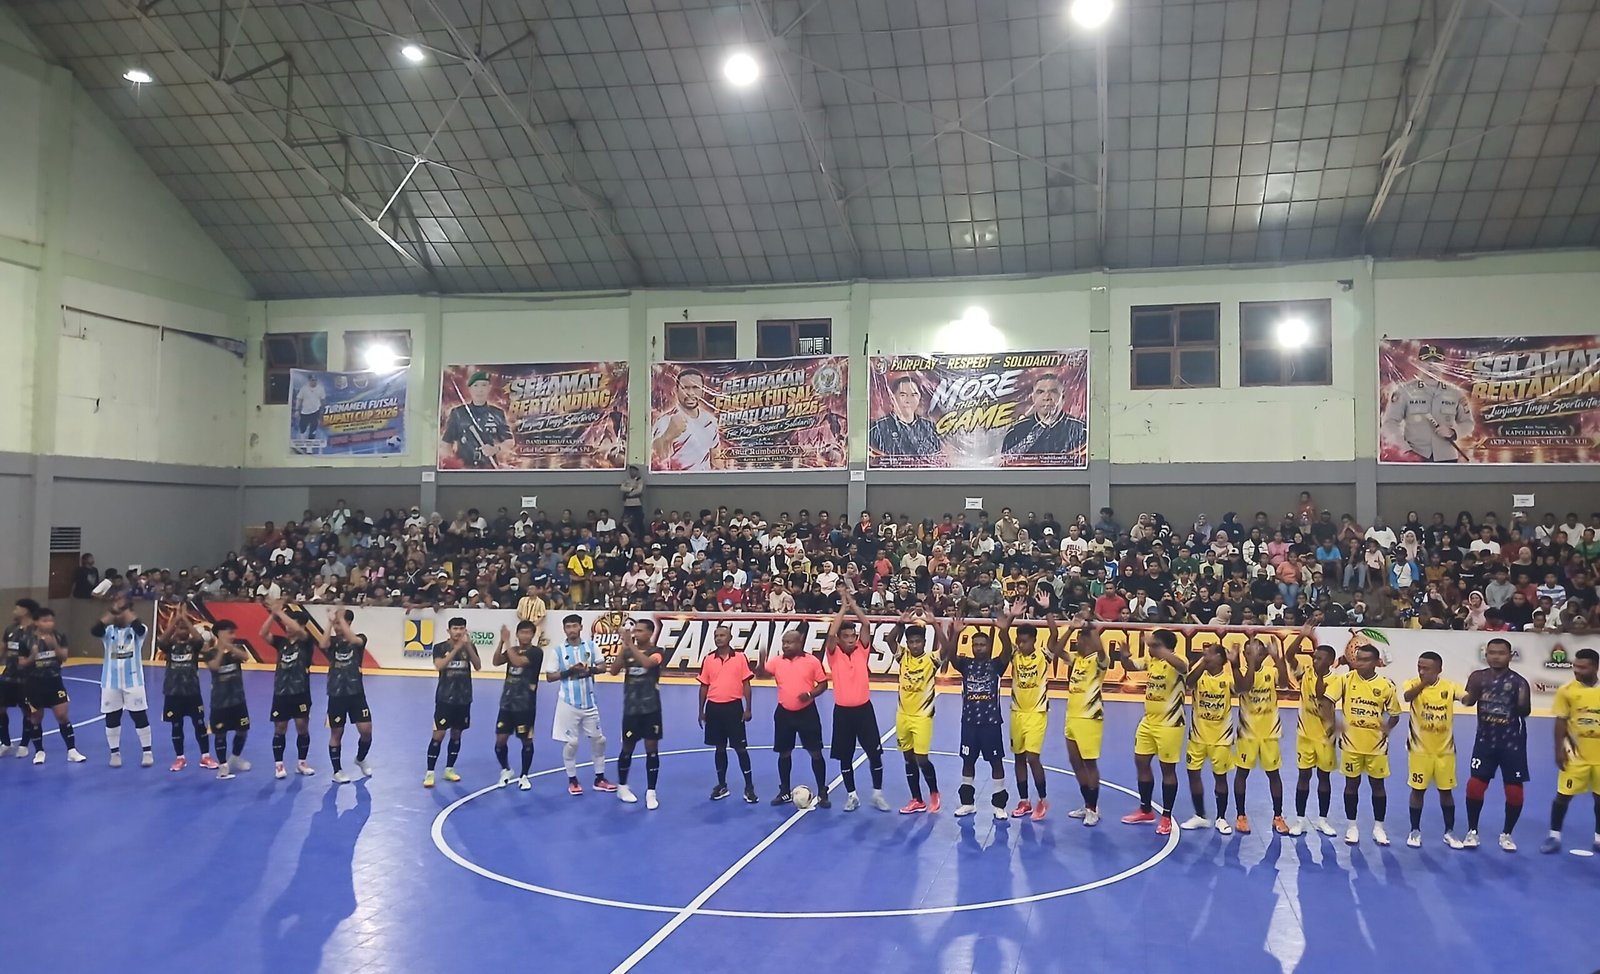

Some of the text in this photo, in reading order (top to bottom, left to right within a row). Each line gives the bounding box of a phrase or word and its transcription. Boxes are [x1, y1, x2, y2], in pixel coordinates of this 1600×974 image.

[890, 354, 1064, 371] FAIRPLAY RESPECT SOLIDARITY
[511, 373, 602, 398] SELAMAT
[722, 369, 805, 393] GELORAKAN
[929, 370, 1026, 410] MORE
[1472, 370, 1600, 401] BERTANDIN
[324, 397, 398, 414] TURNAMEN FUTSAL
[509, 389, 612, 416] BERTANDING
[716, 385, 813, 410] FAKFAK FUTSAL
[955, 400, 980, 409] THEN
[355, 411, 373, 421] CUP
[374, 407, 399, 419] 2026
[760, 404, 786, 420] CUP
[786, 400, 819, 418] 2026
[1525, 400, 1550, 415] Tinggi
[935, 401, 1020, 435] GAME
[600, 645, 621, 657] CU
[1241, 753, 1247, 763] 4
[1412, 772, 1424, 783] 95
